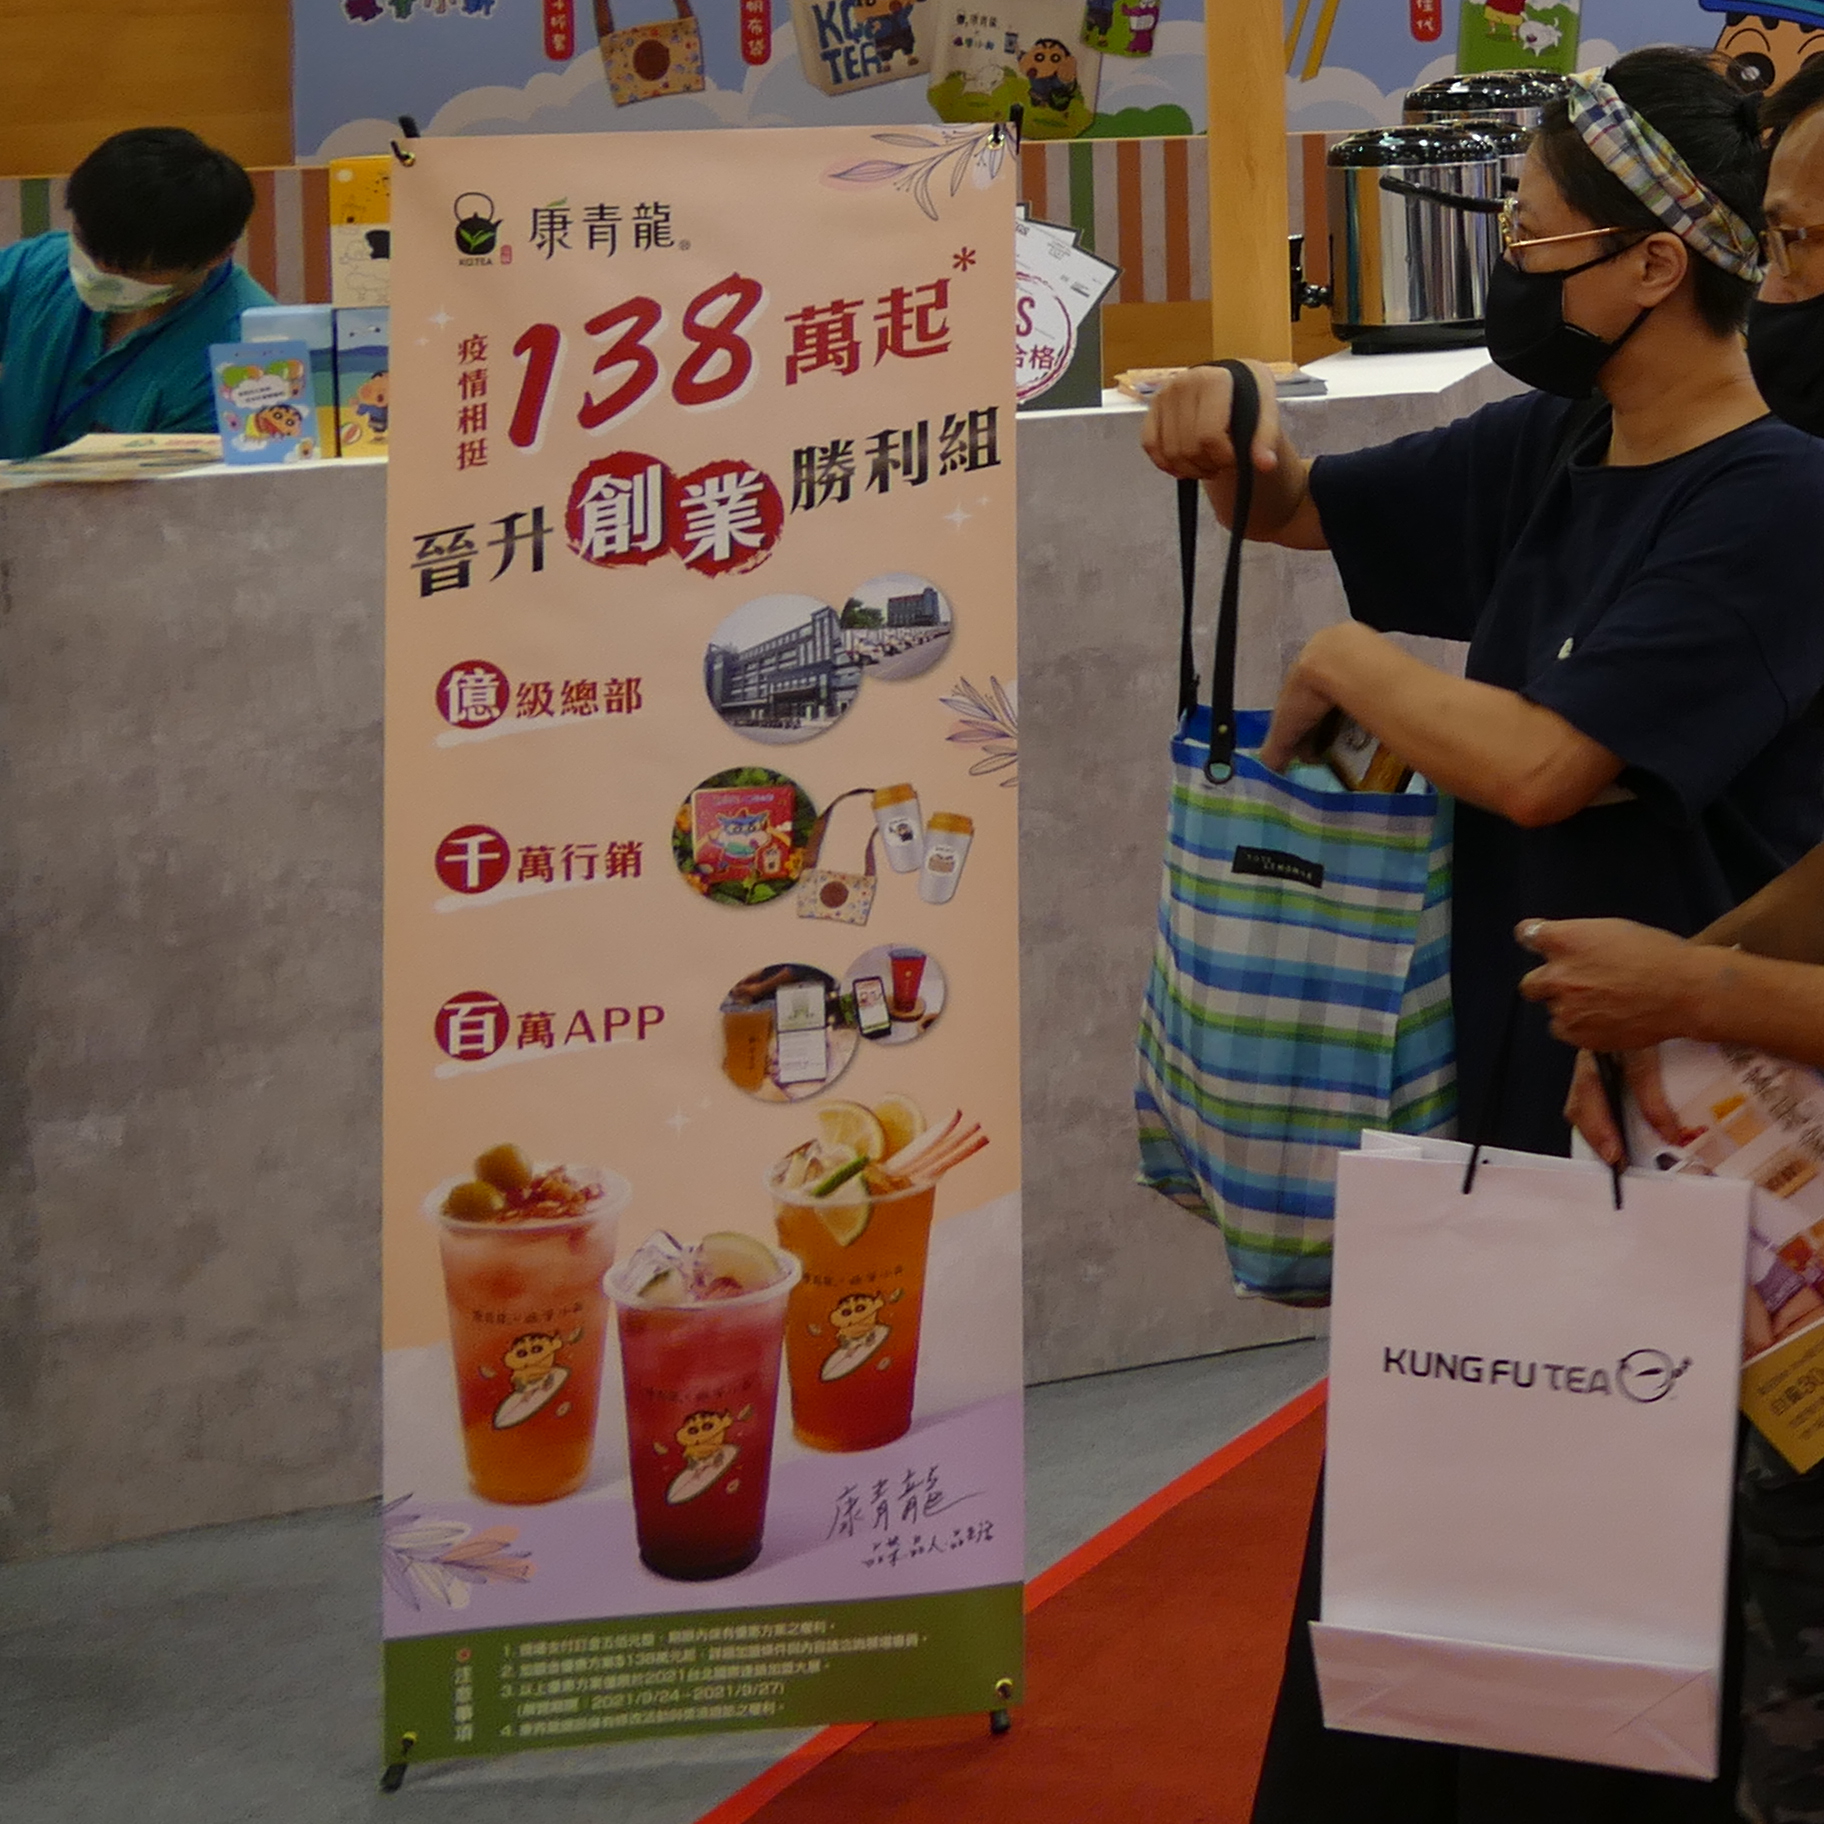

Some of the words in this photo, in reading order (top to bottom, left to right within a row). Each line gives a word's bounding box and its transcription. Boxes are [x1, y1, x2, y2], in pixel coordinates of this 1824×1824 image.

[529, 198, 675, 260] 康青龍
[457, 334, 489, 471] 疫情相挺
[445, 667, 644, 725] 億級總部
[444, 832, 645, 889] 千萬行銷
[1383, 1346, 1484, 1384] KUNG
[1490, 1359, 1537, 1389] FU
[1544, 1363, 1613, 1396] TEA
